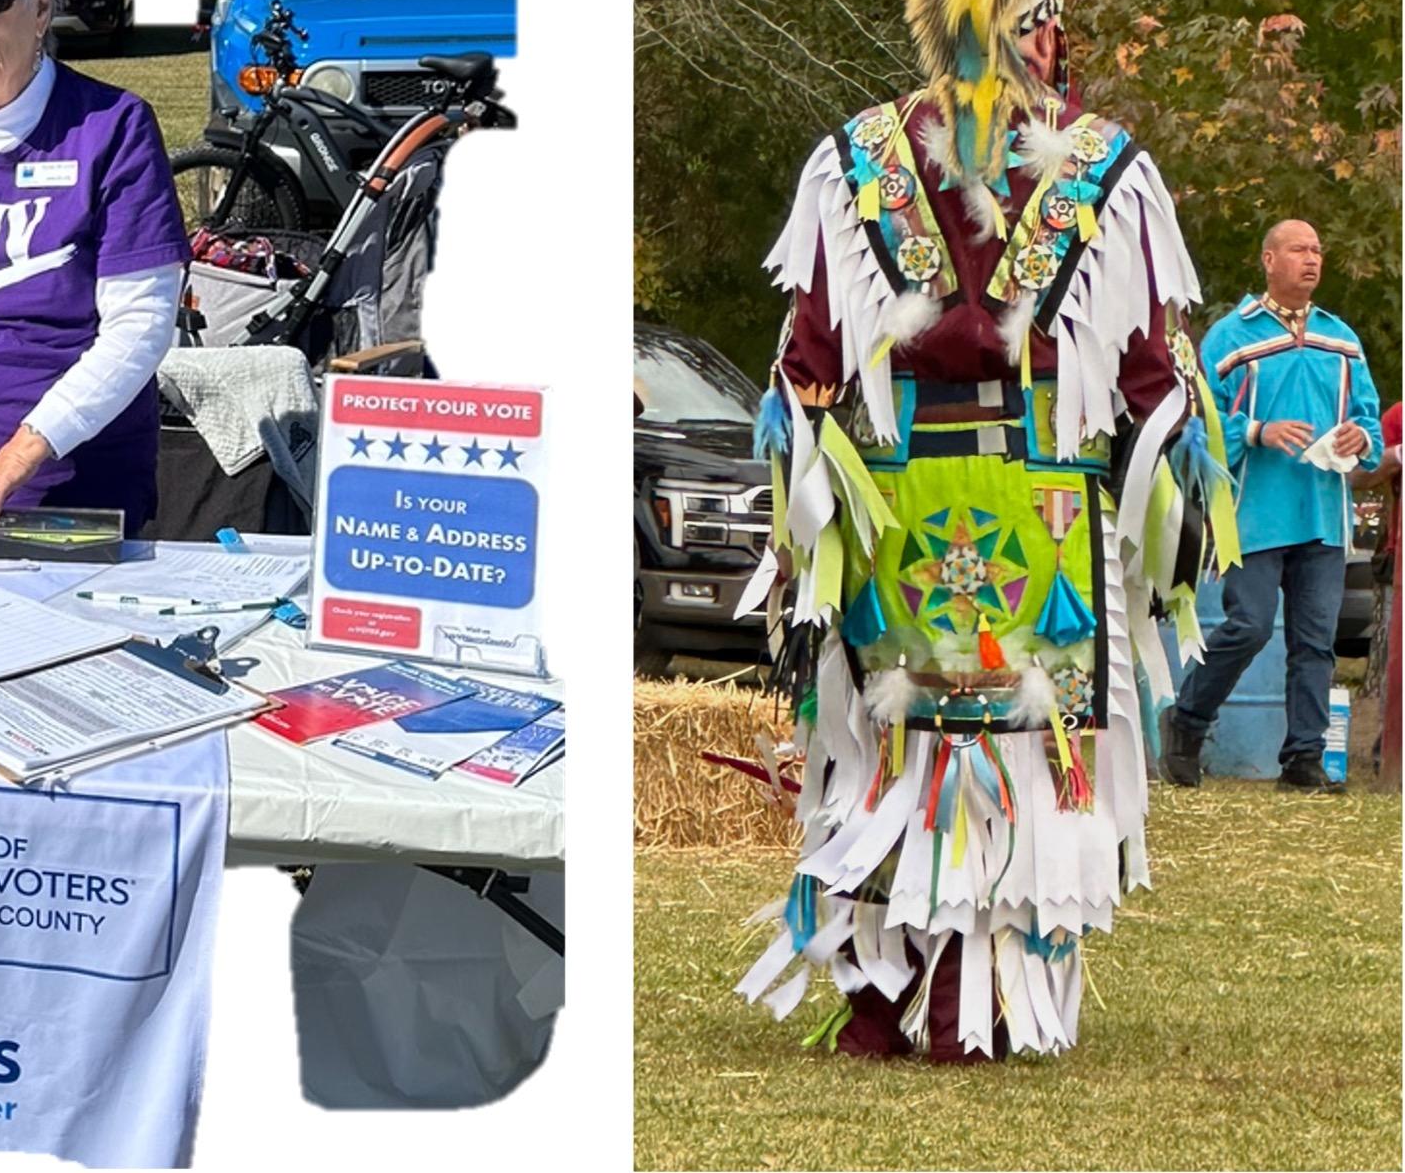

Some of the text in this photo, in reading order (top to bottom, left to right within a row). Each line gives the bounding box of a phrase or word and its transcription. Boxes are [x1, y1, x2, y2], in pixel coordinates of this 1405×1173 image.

[342, 394, 532, 420] PROTECT YOUR VOTE
[418, 496, 468, 515] YOUR
[335, 514, 528, 553] NAME & ADDRESS
[350, 547, 508, 585] UP-TO-DATE?
